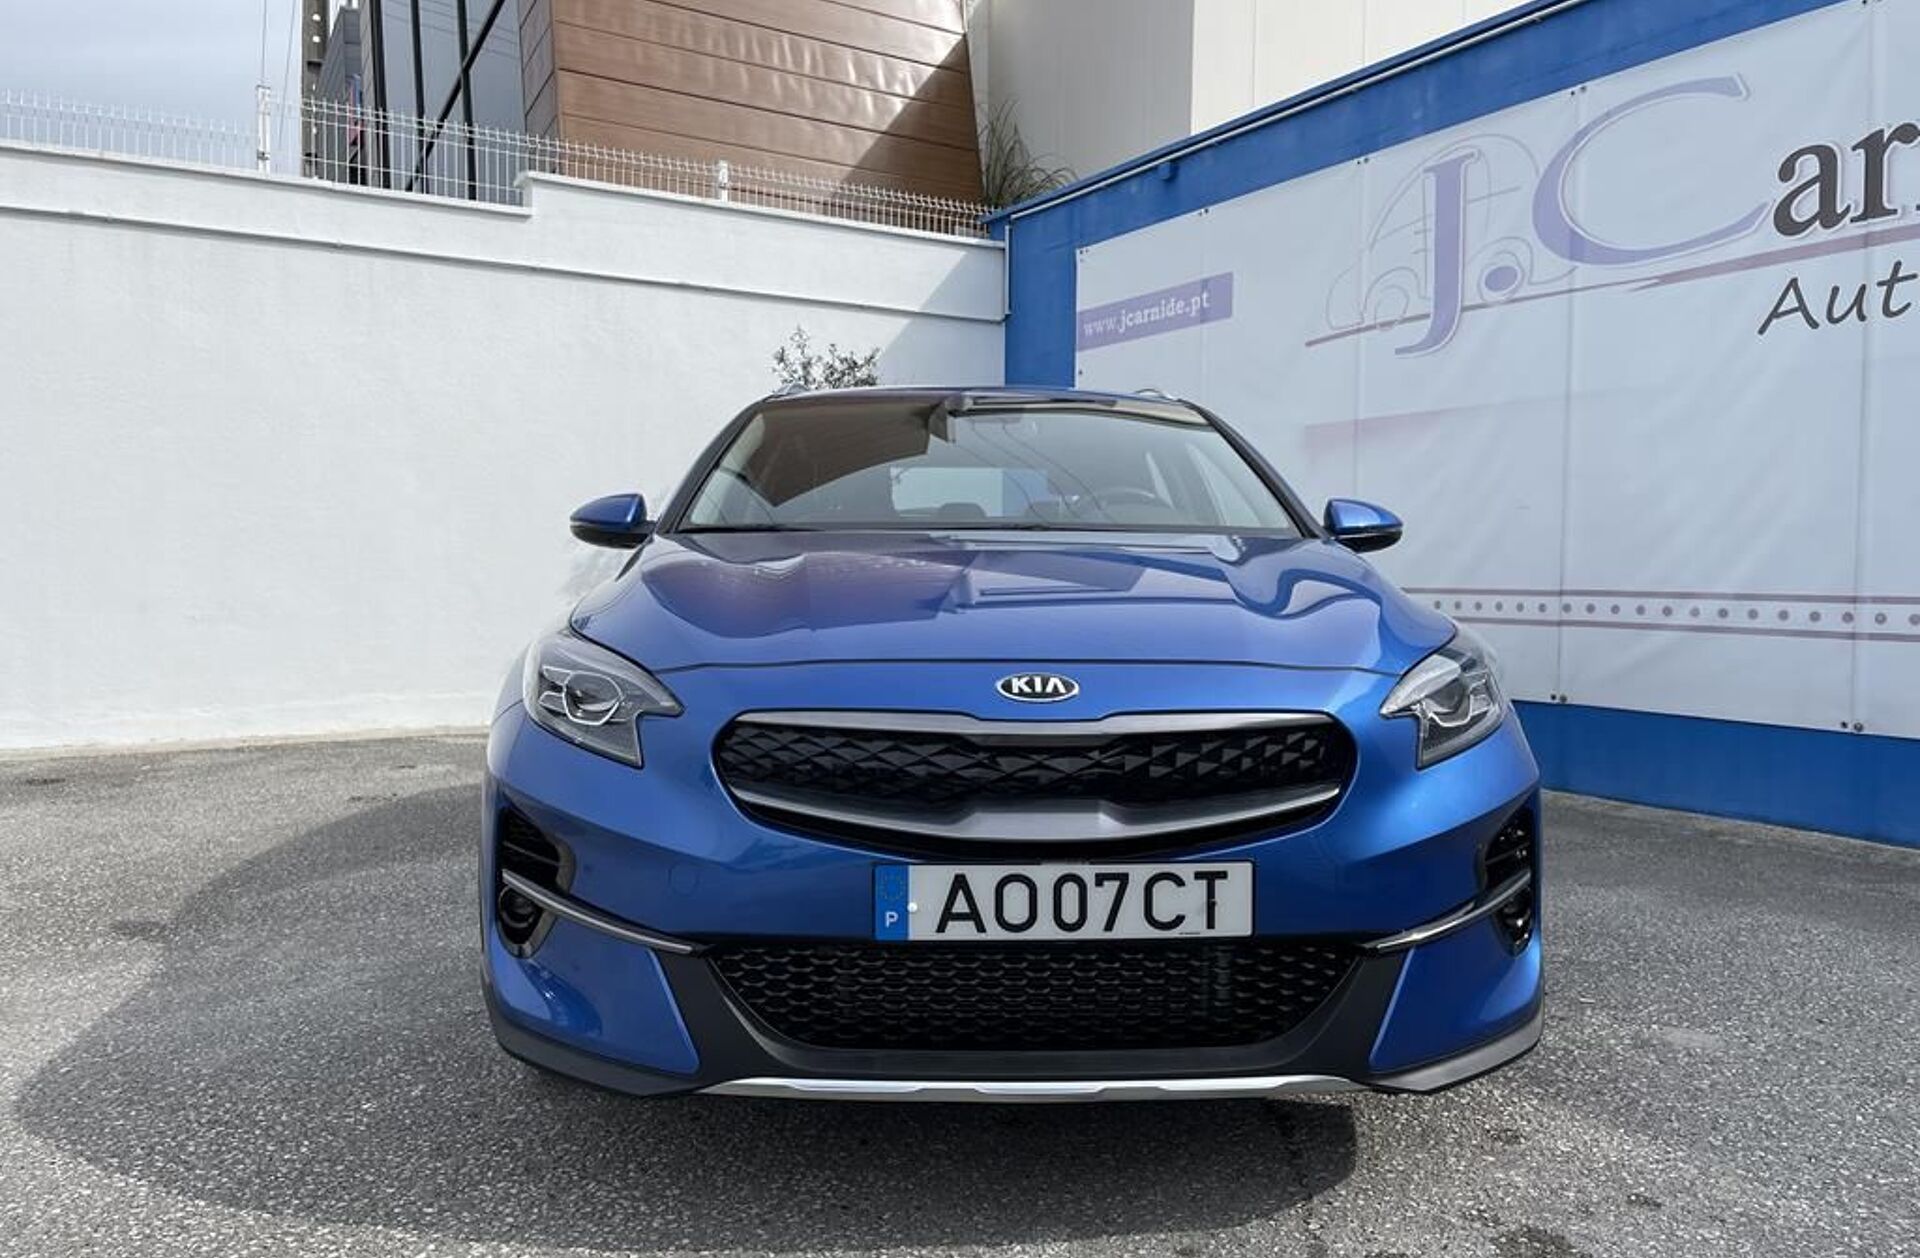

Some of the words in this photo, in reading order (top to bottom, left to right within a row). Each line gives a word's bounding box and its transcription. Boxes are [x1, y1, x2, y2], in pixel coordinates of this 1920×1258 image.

[1394, 75, 1920, 356] J.Car
[1083, 289, 1210, 337] www.jcarnide.pt
[1011, 676, 1067, 693] KIA
[885, 911, 899, 928] P
